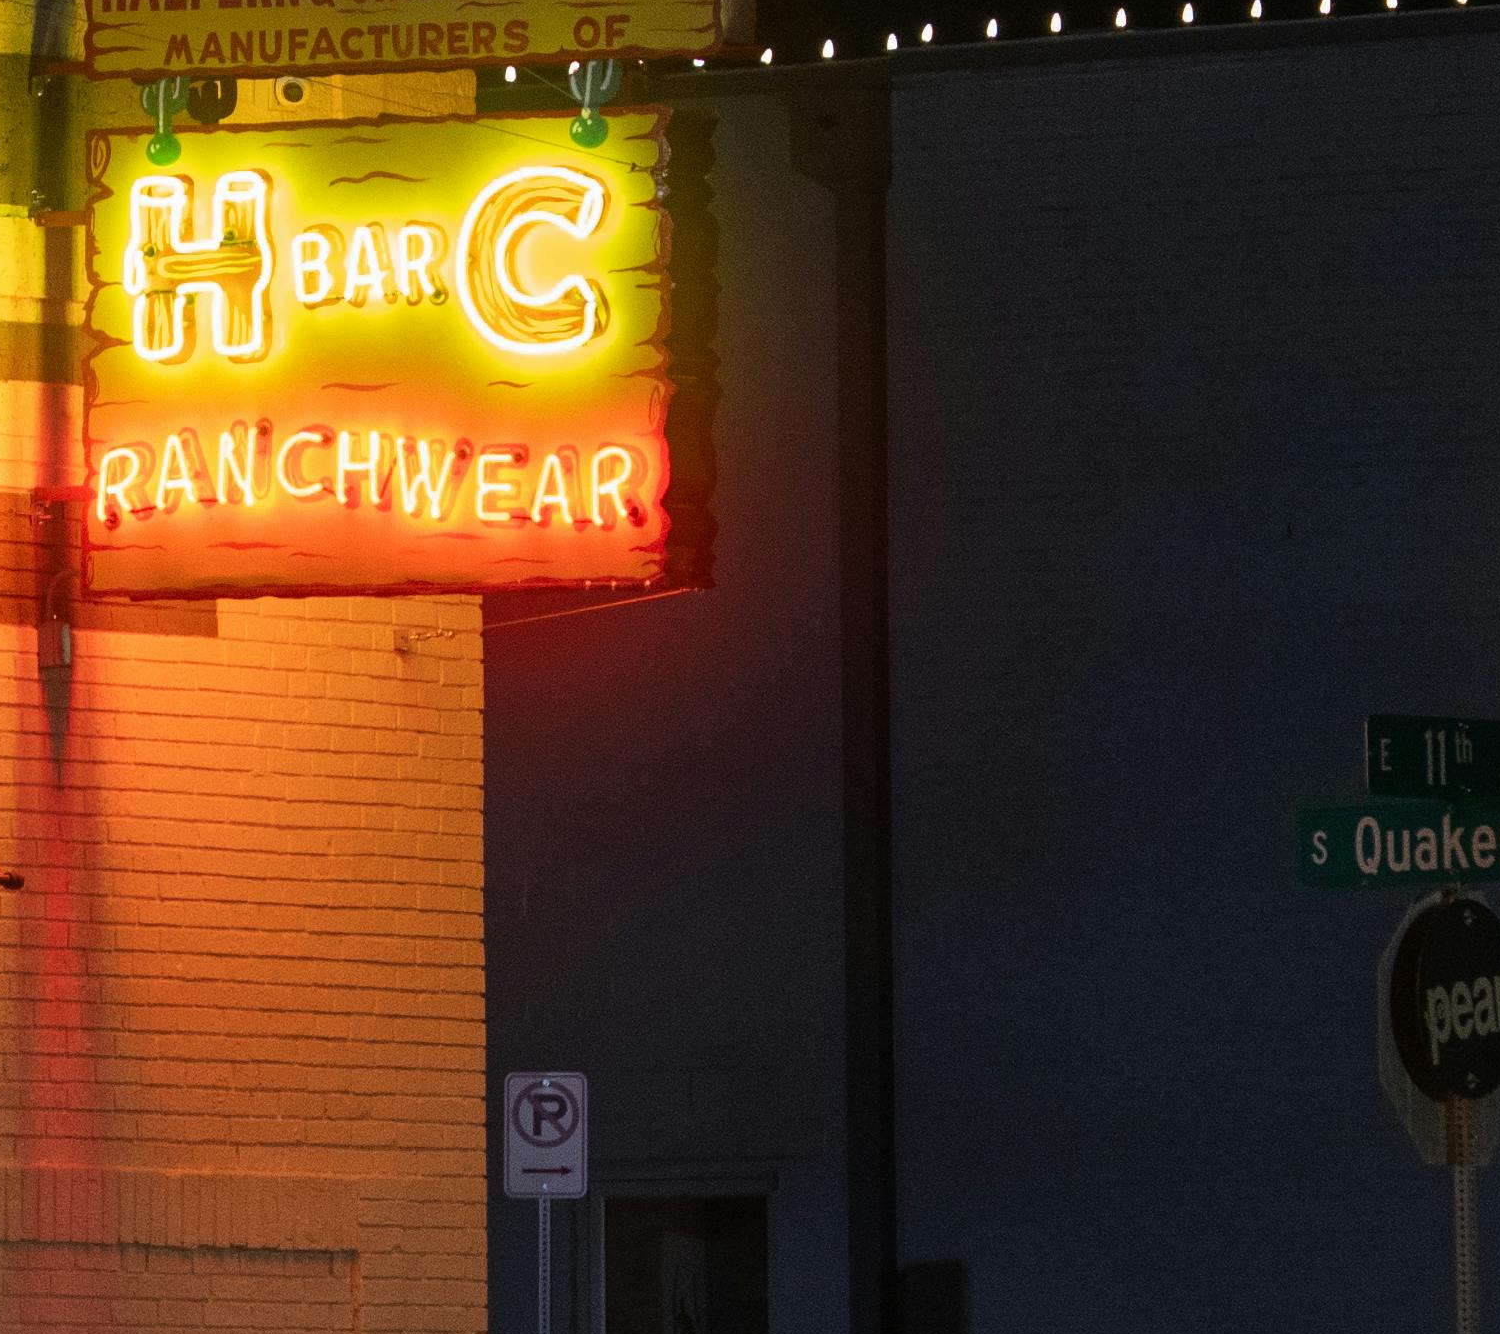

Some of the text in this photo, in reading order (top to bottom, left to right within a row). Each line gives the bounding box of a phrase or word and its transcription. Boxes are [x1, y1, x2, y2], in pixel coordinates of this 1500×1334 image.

[163, 14, 632, 65] MANUFACTURERS OF
[128, 164, 610, 363] H BAR C
[95, 419, 648, 528] RANCHWEAR
[1380, 737, 1392, 771] E
[1424, 729, 1473, 786] 11th
[1311, 829, 1328, 866] S
